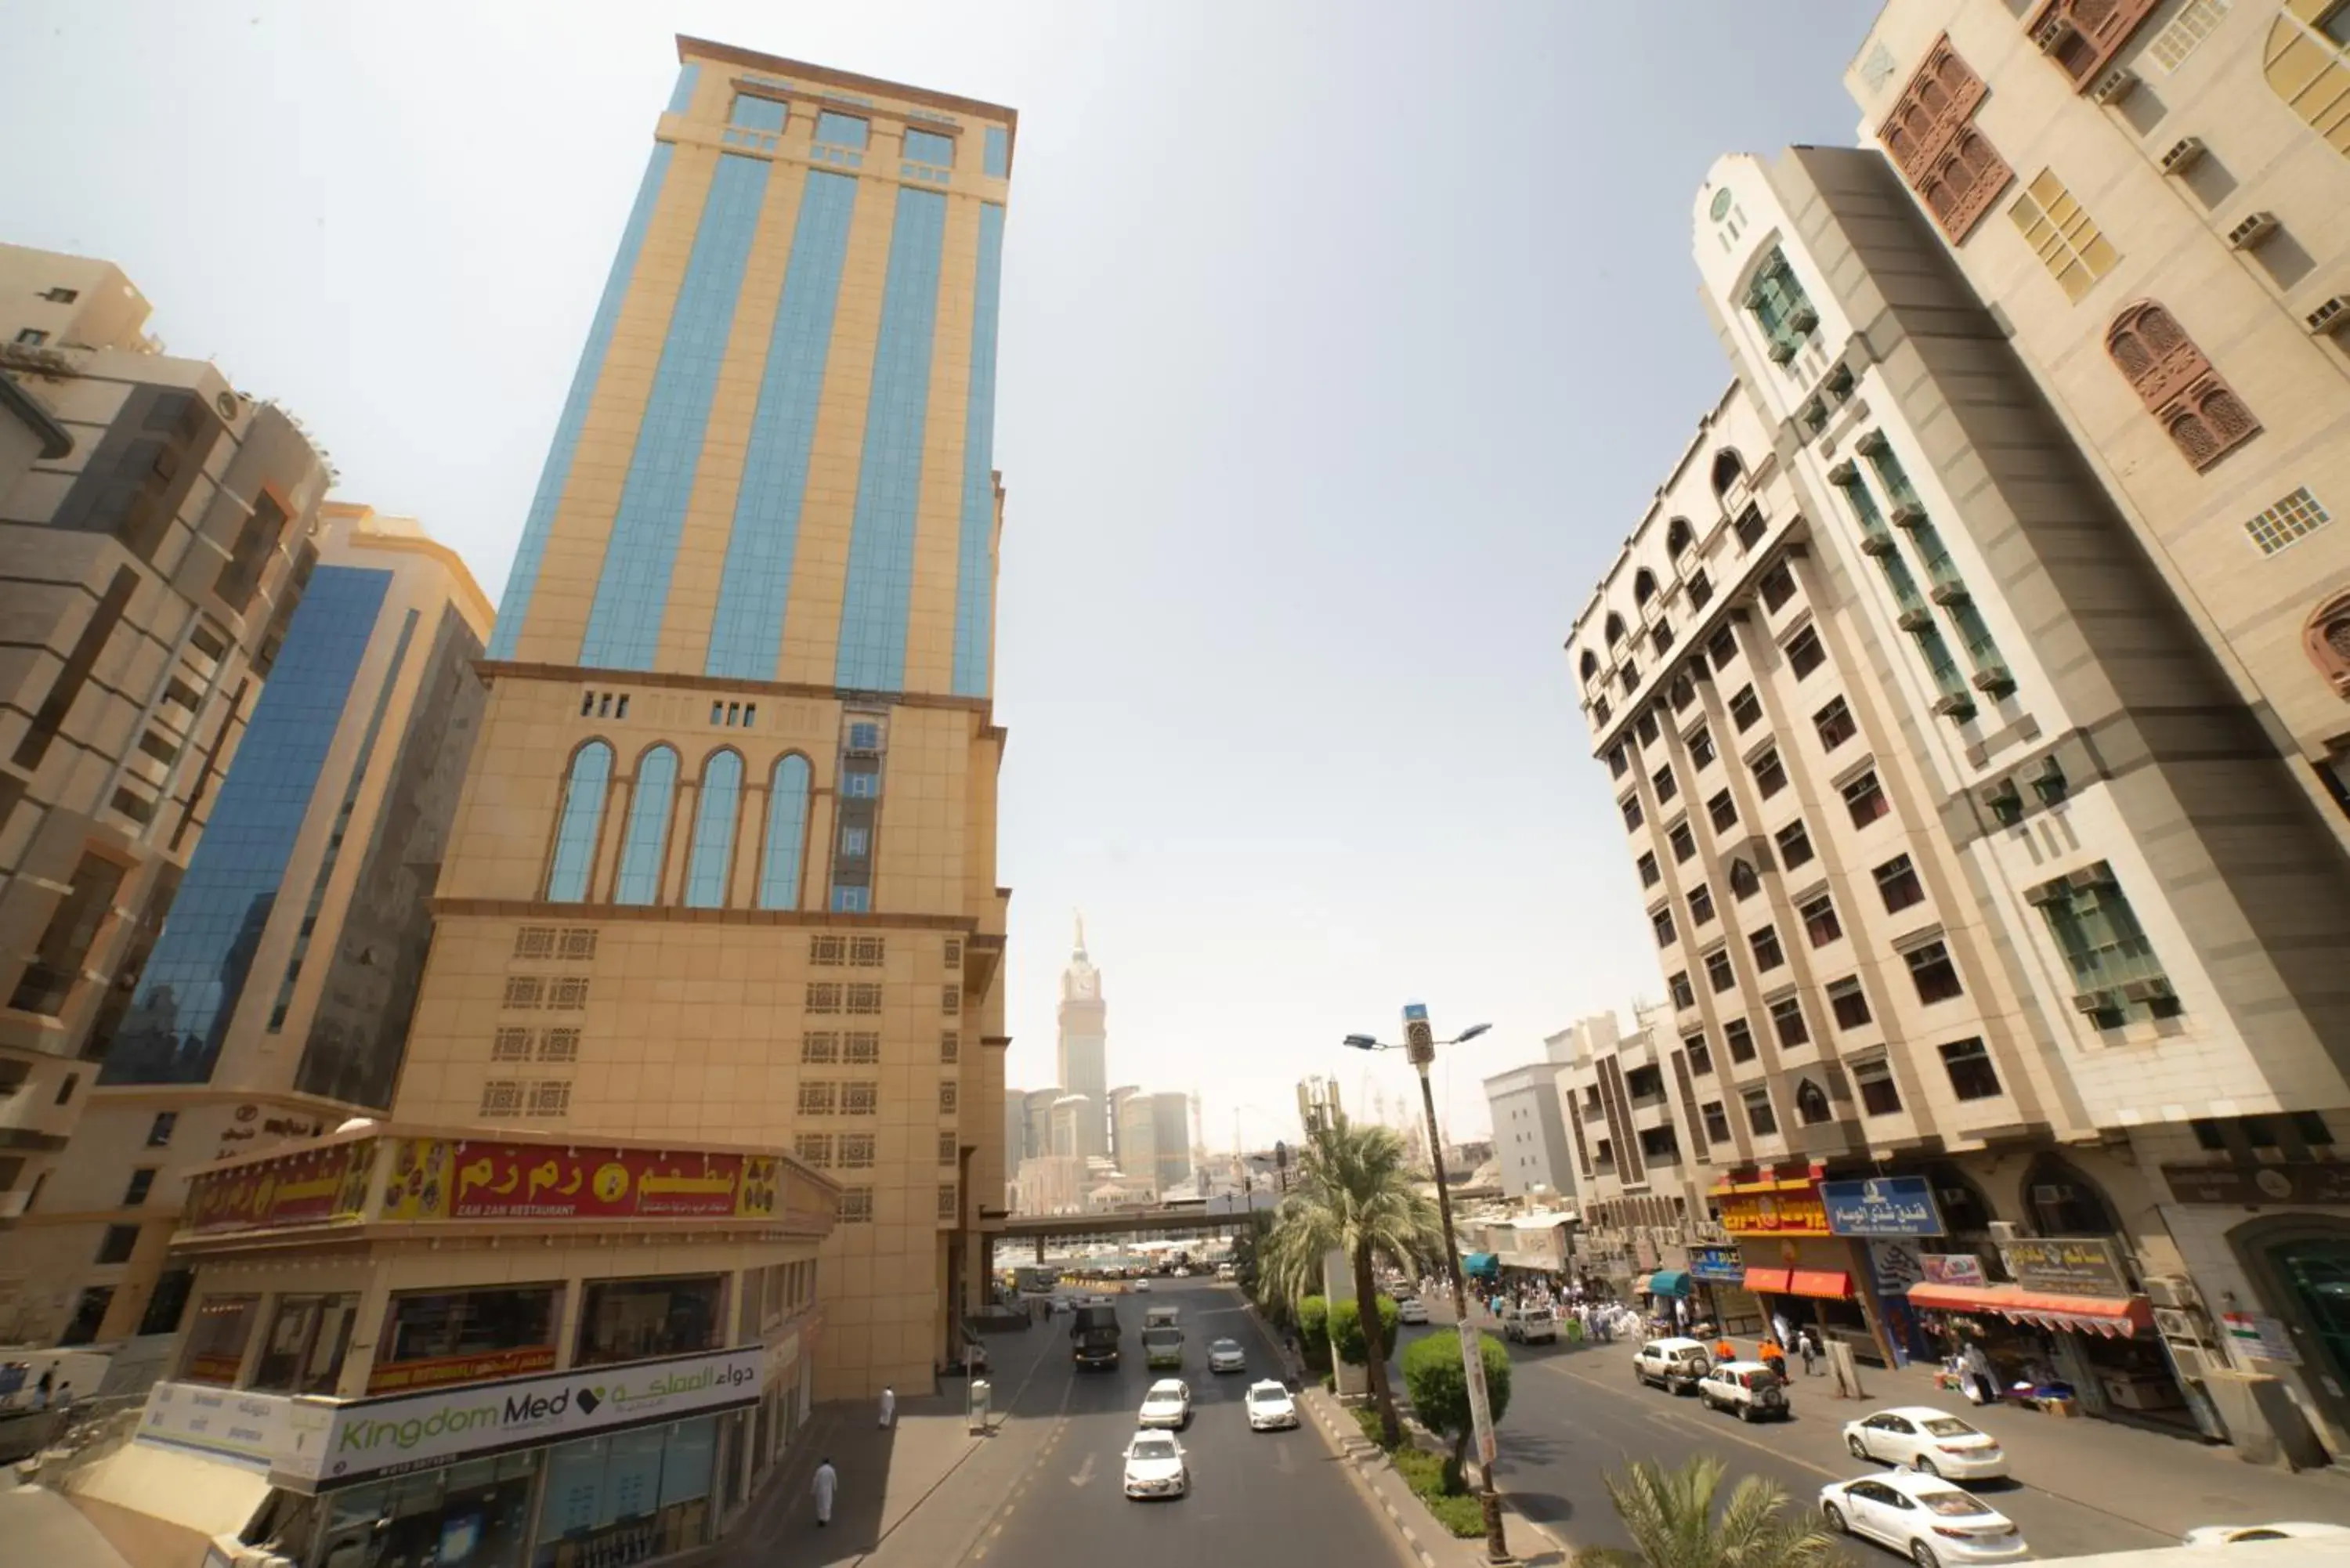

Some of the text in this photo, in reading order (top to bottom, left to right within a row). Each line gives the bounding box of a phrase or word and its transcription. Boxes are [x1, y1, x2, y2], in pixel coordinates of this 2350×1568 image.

[637, 1158, 735, 1211] مطعم
[457, 1204, 577, 1216] ZAM ZAM RESTAURANT
[1896, 1201, 1929, 1223] فندق
[610, 1364, 754, 1404] دواء المملكة
[338, 1406, 500, 1452] Kingdom
[503, 1388, 570, 1425] Med
